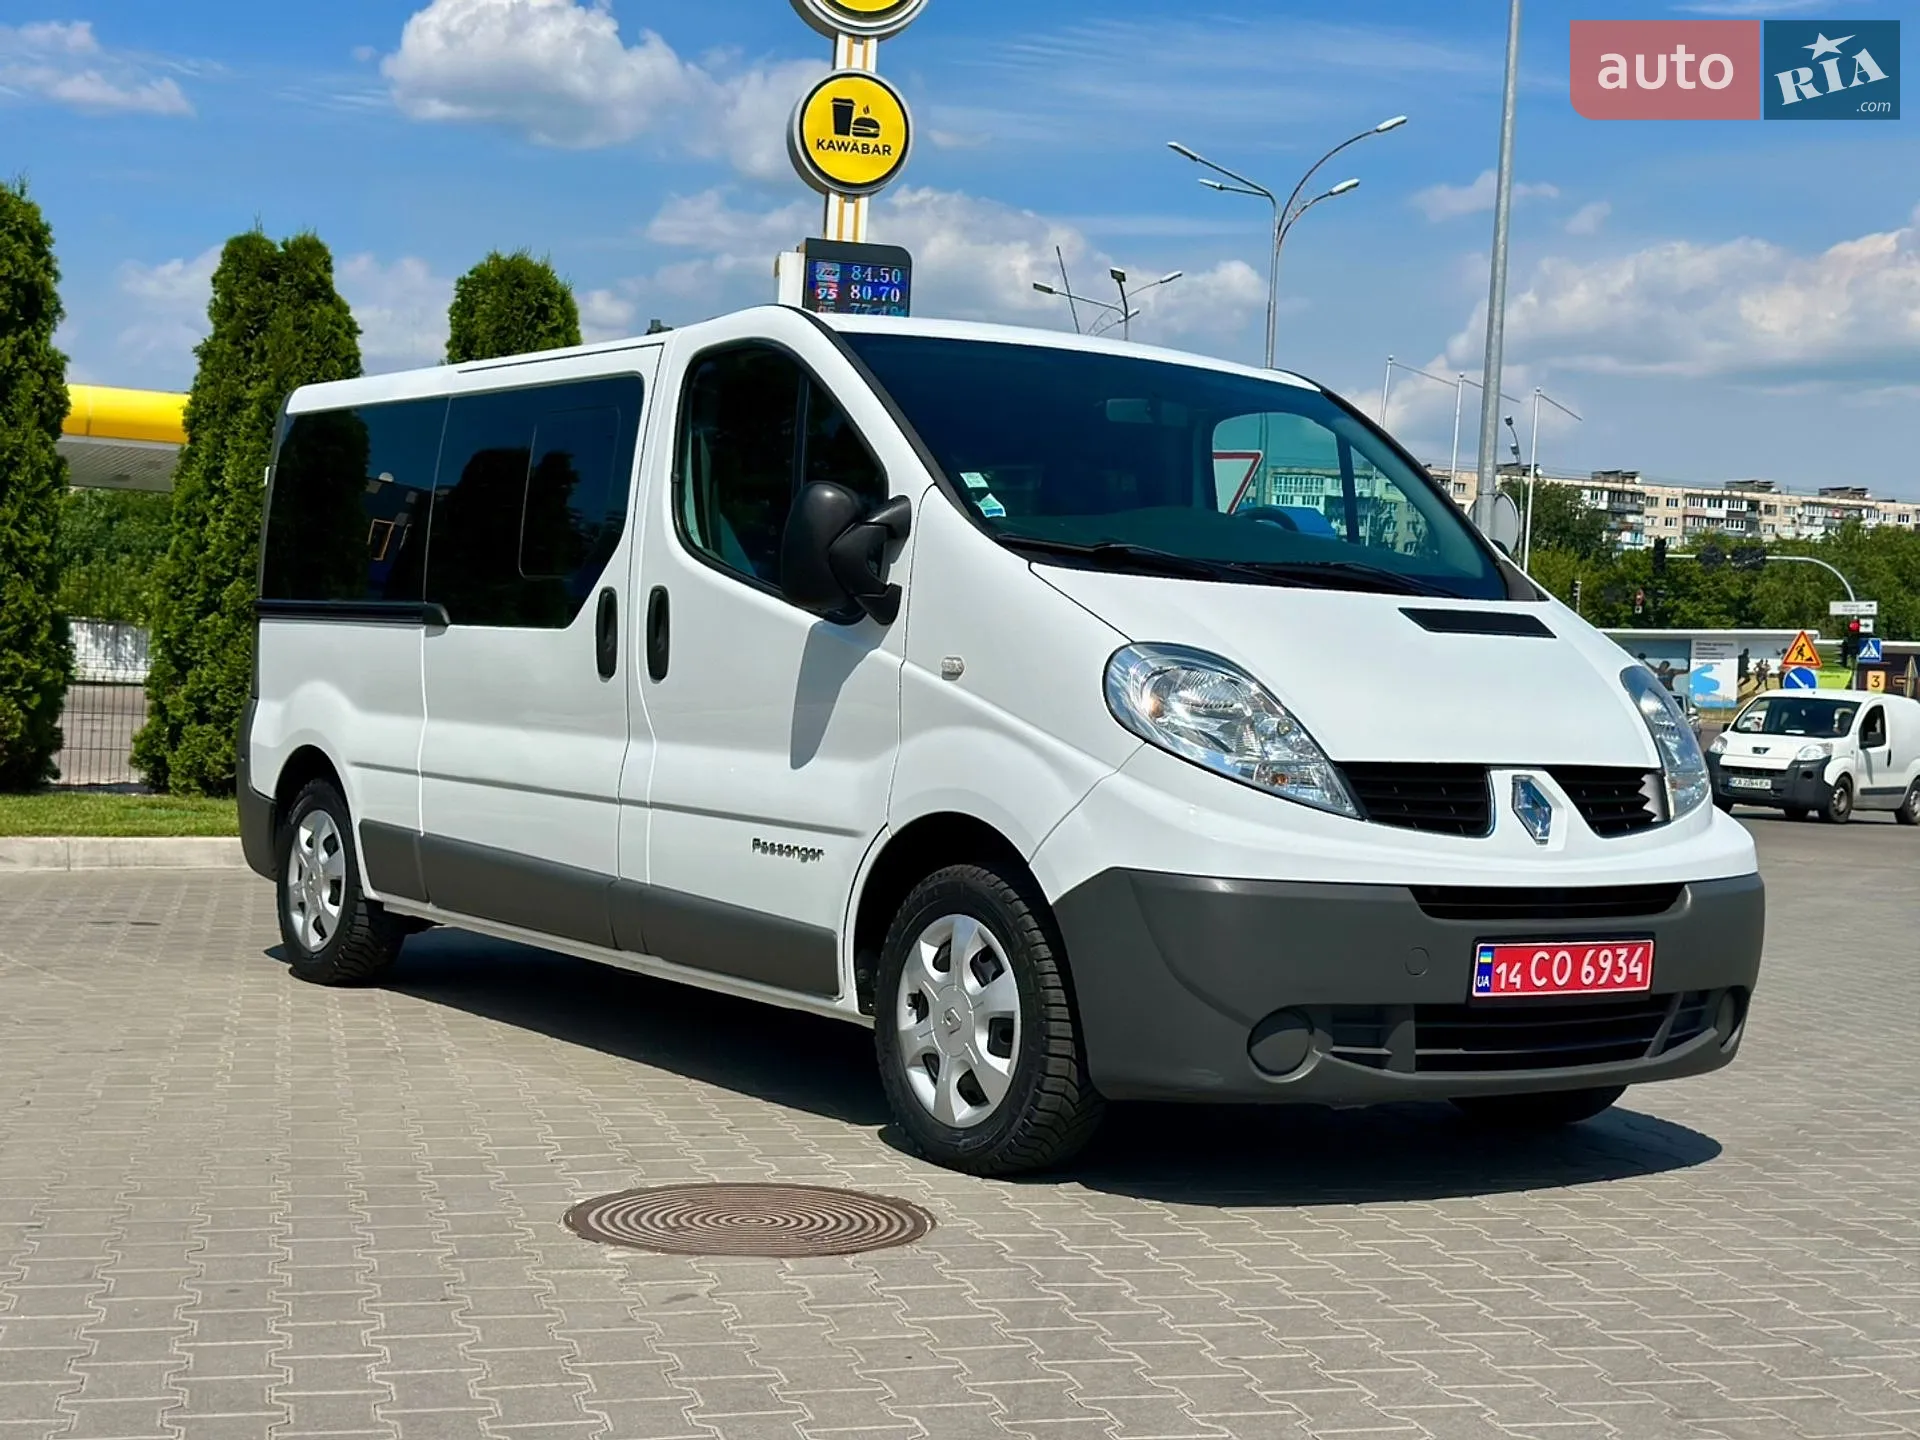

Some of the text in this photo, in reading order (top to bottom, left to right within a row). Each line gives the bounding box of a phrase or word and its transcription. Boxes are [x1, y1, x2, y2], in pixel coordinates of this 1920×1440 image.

[851, 265, 901, 284] 84.50
[817, 284, 900, 303] 95 80.70
[1871, 675, 1881, 688] 3
[752, 837, 825, 863] Passenger
[1495, 947, 1645, 989] 14 CO 6934
[1477, 976, 1490, 987] UA
